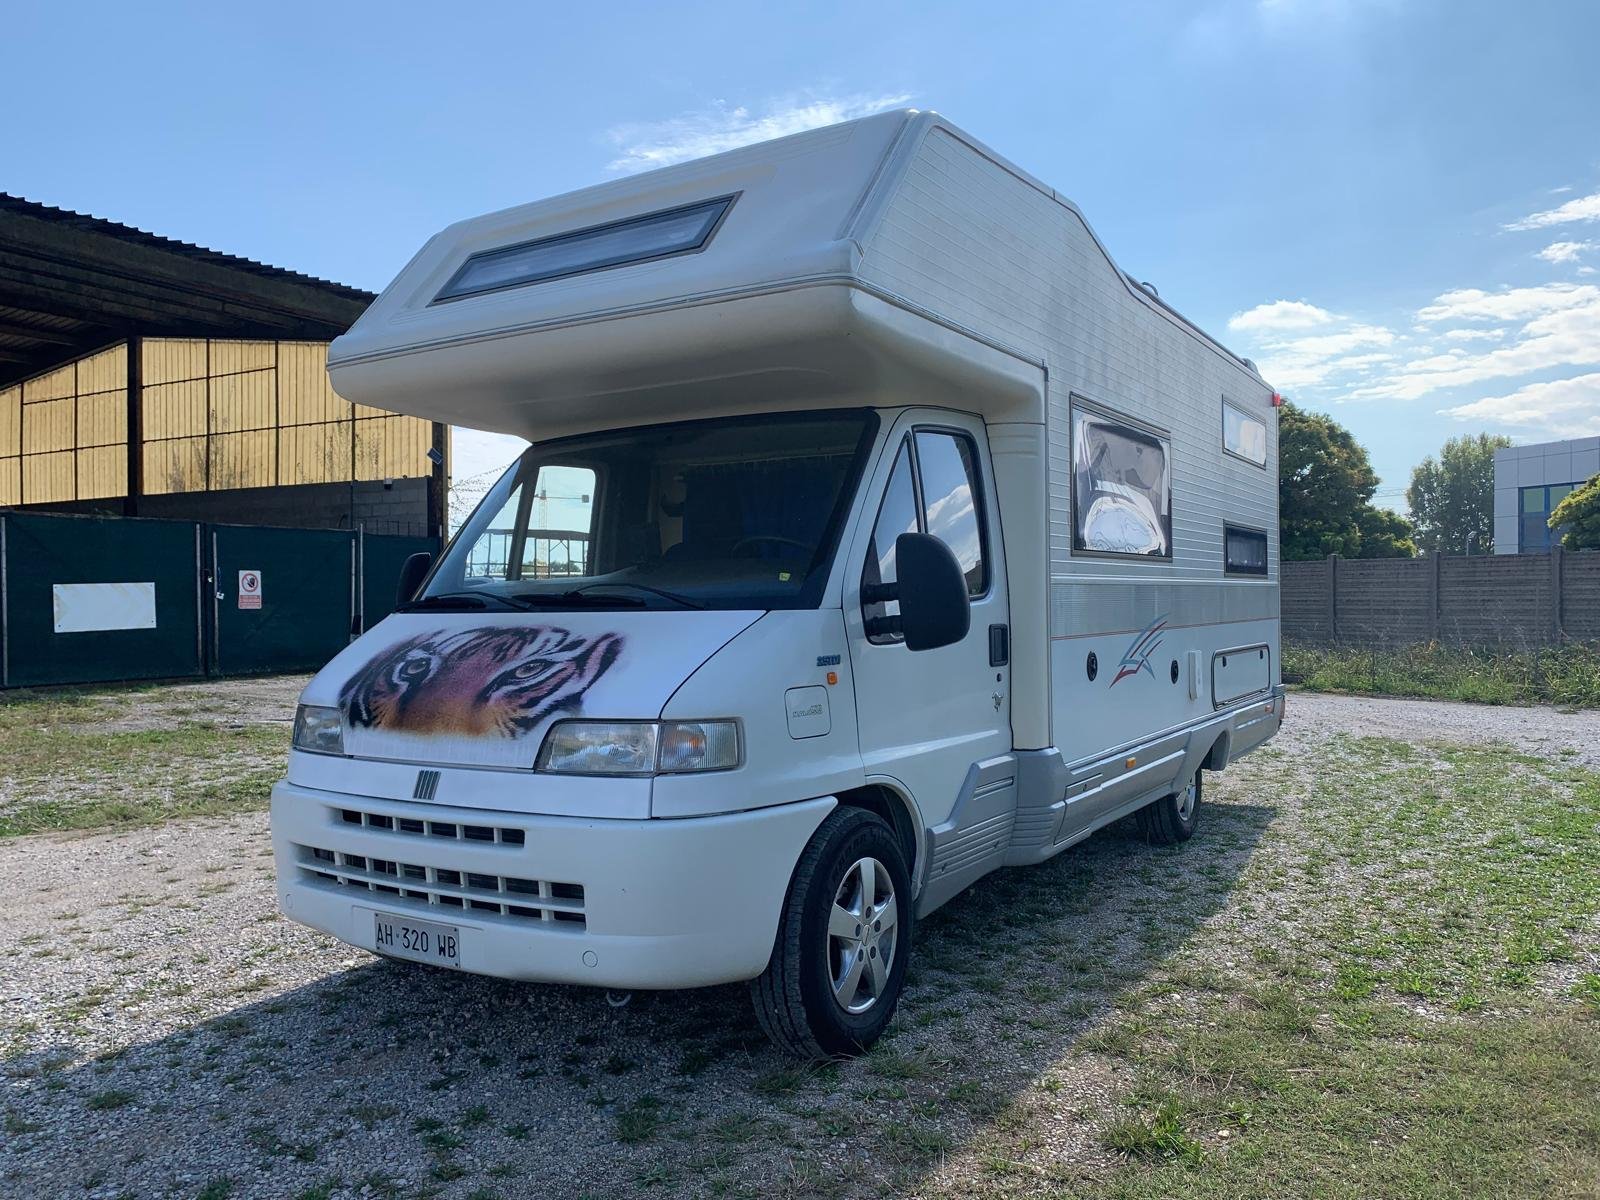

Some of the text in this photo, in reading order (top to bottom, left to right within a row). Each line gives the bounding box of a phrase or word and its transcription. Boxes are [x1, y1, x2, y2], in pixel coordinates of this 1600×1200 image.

[377, 922, 456, 958] AH 320 WB
